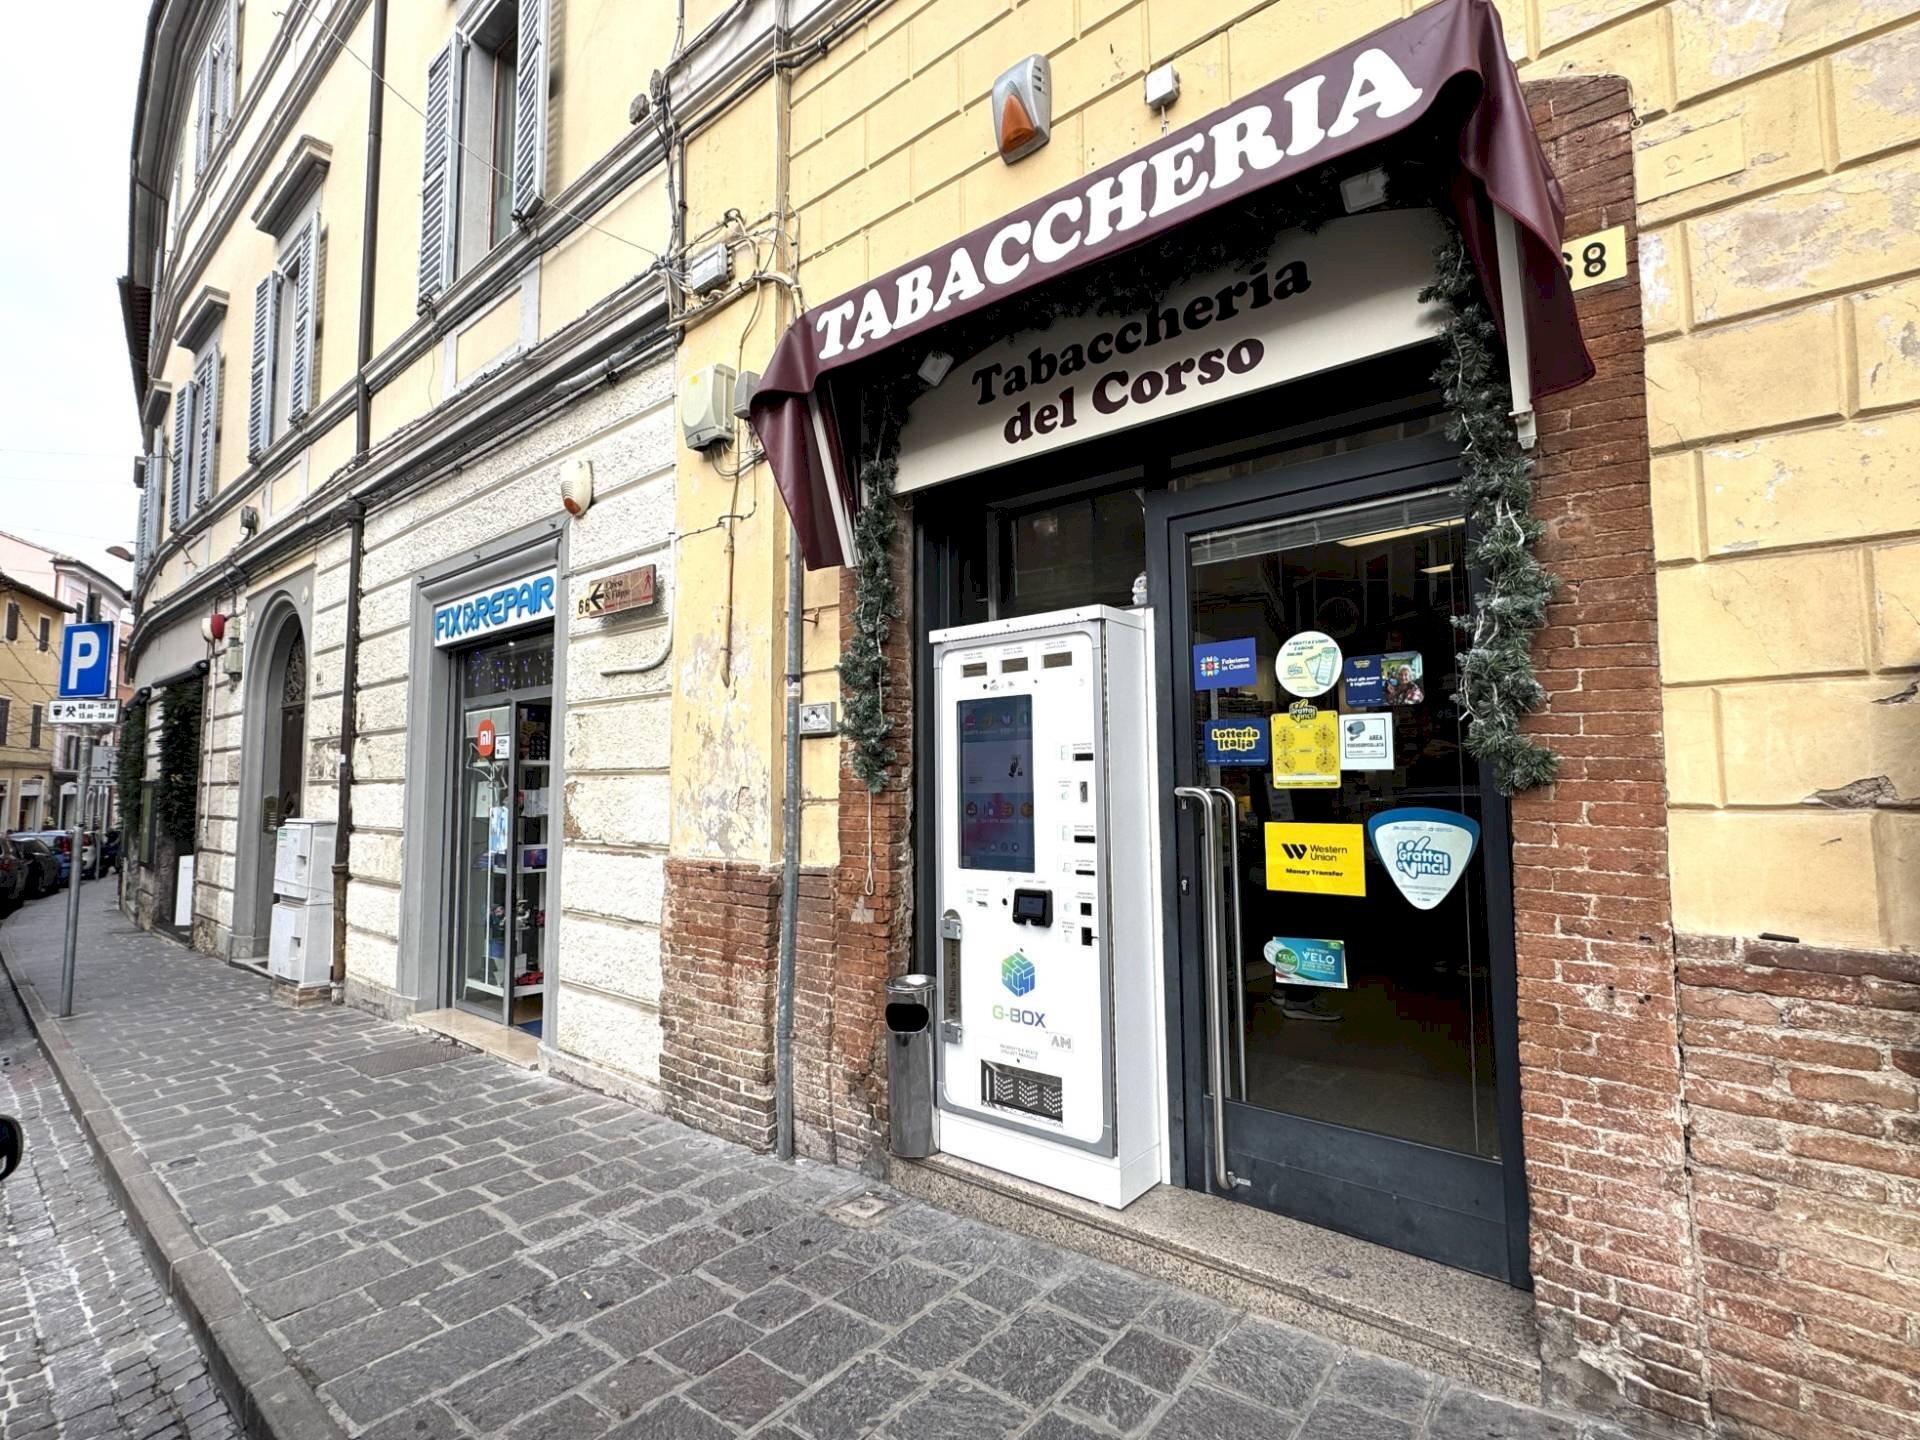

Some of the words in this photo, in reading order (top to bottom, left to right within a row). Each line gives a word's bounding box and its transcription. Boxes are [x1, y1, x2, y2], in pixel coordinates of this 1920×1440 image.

[816, 48, 1423, 360] TABACCHERIA
[972, 260, 1312, 405] Tabaccheria
[1004, 386, 1077, 444] del
[1092, 338, 1265, 415] Corso
[578, 598, 591, 614] 66
[67, 631, 101, 690] P
[1213, 729, 1259, 739] Lotteria
[1219, 738, 1254, 750] Italia
[1310, 845, 1348, 854] Western
[1399, 849, 1442, 863] Gratta
[1310, 853, 1337, 861] Union
[1277, 953, 1297, 962] VELO
[1302, 951, 1335, 965] VELO
[992, 1005, 1046, 1028] G-BOX
